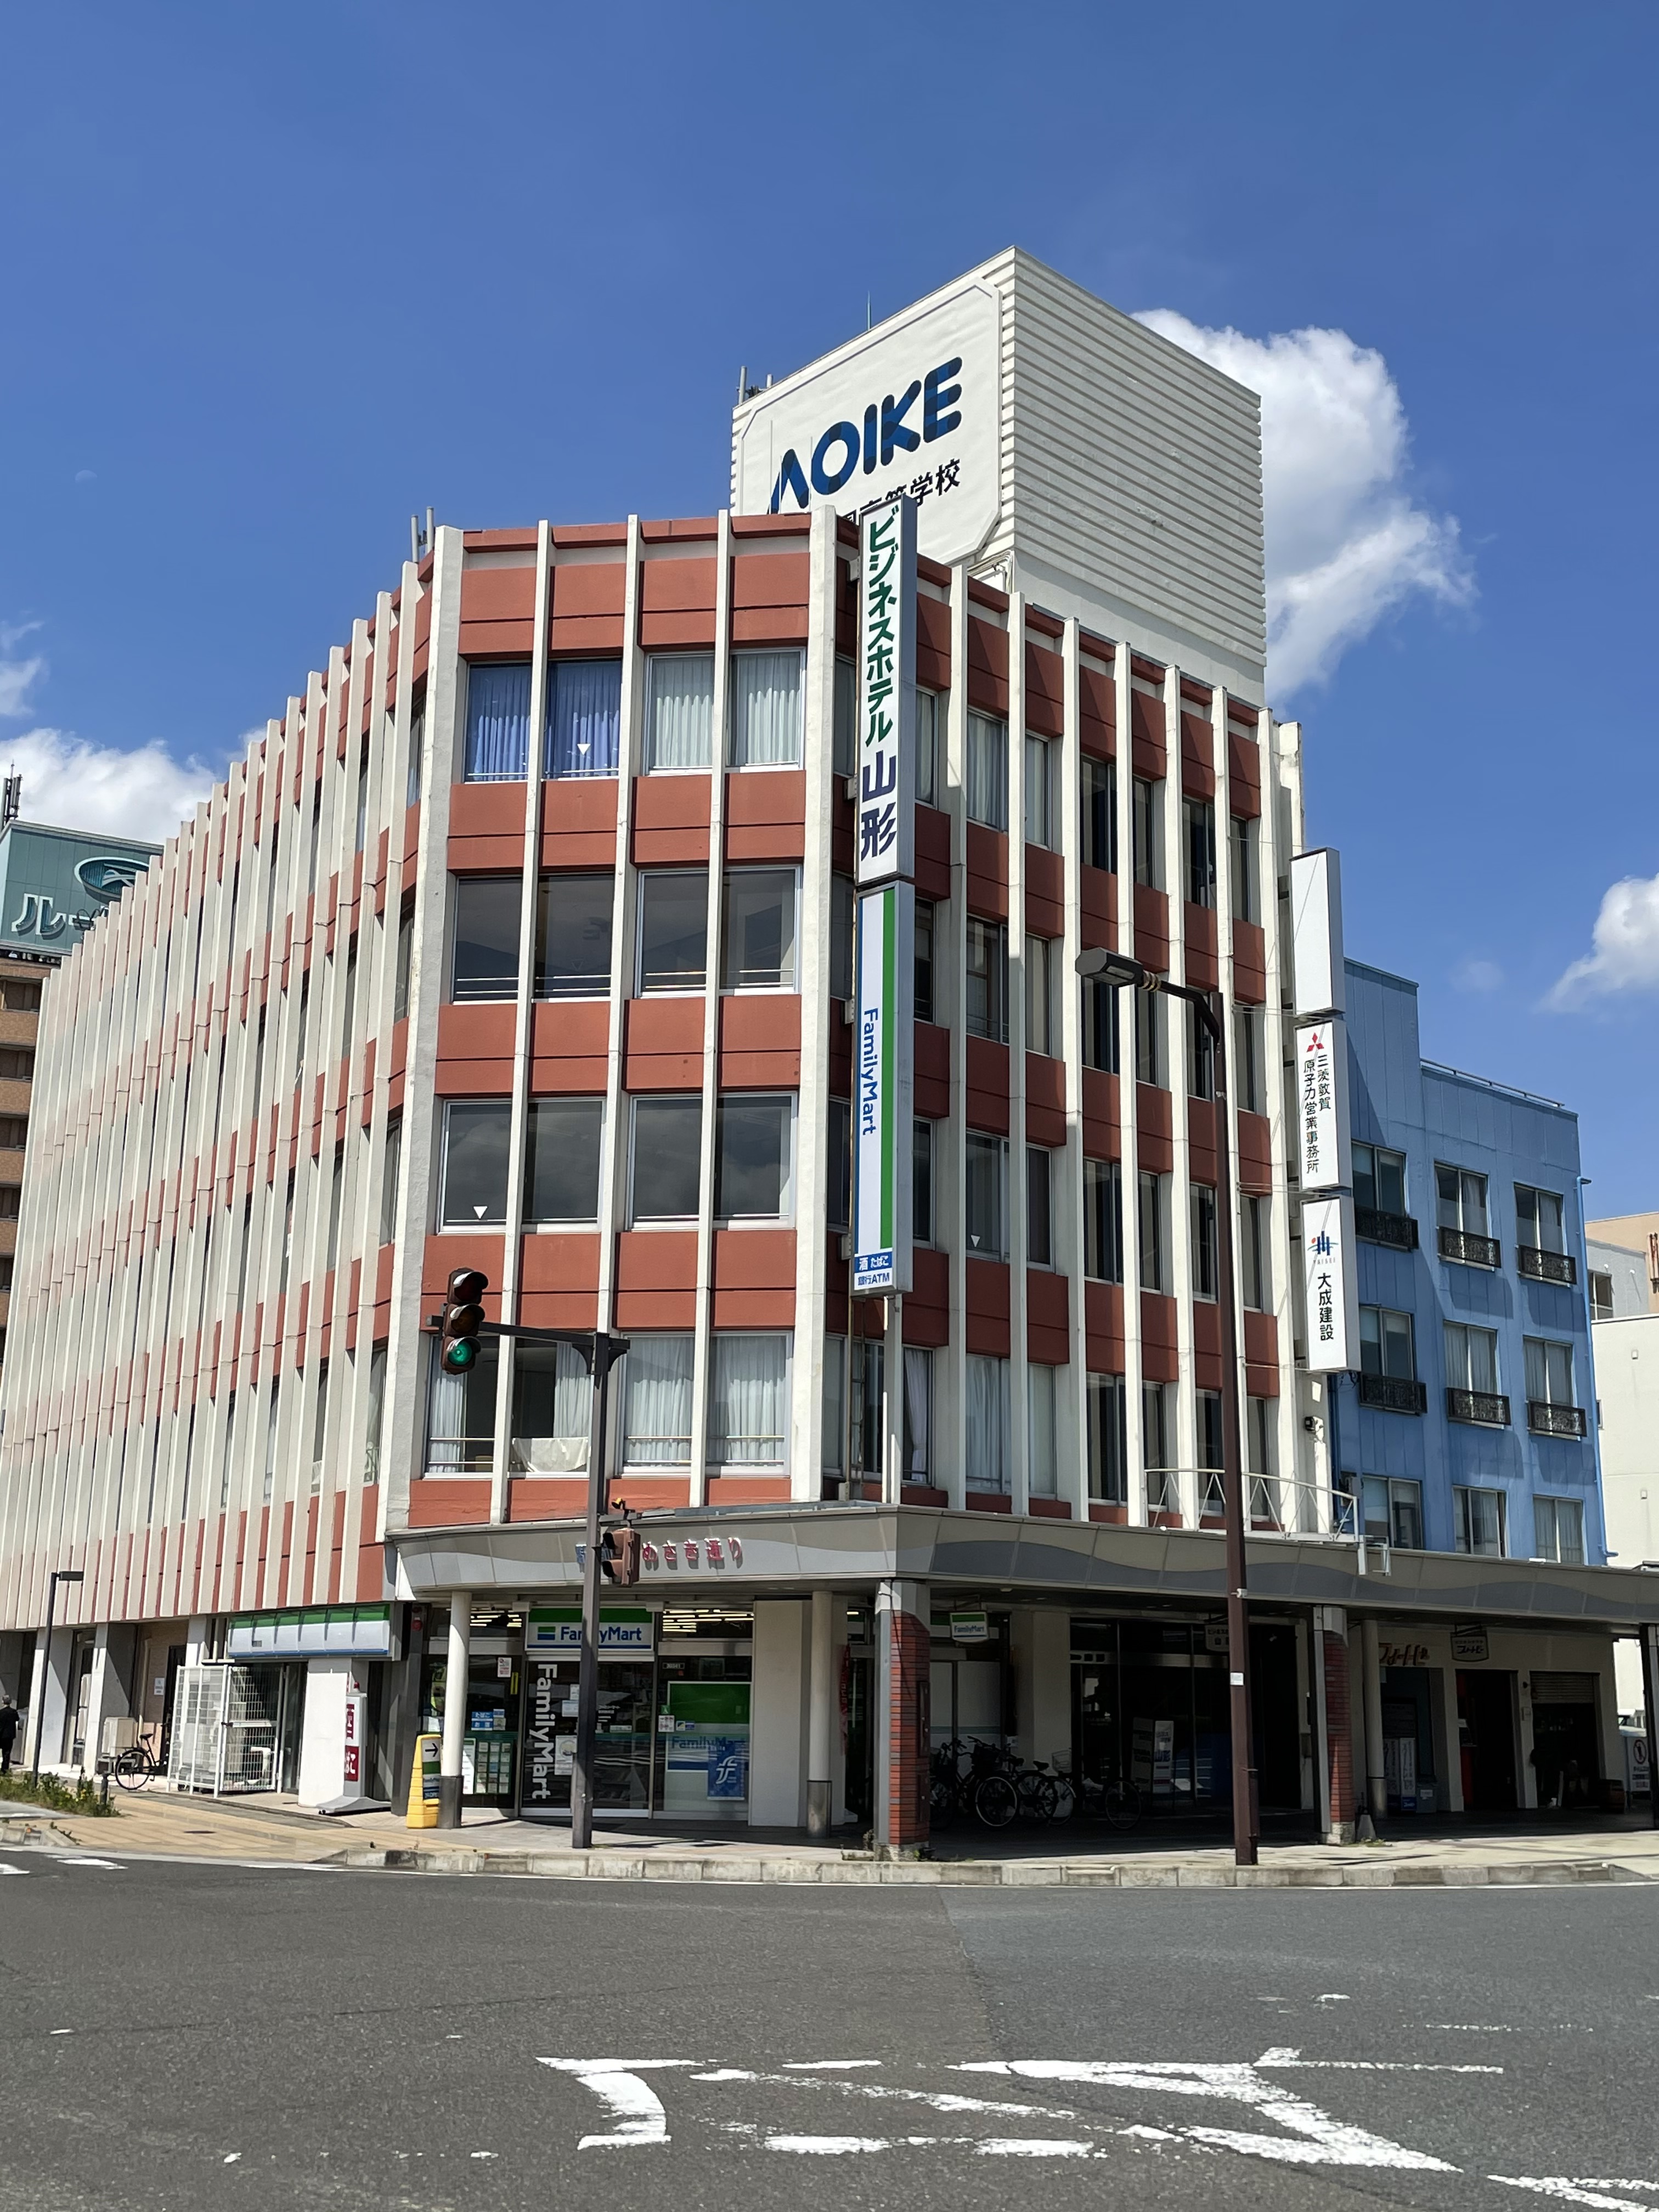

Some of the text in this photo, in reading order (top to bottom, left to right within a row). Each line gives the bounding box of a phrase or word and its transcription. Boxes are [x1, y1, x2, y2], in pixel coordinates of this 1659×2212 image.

[768, 357, 962, 514] AOIKE
[862, 1008, 878, 1136] FamilyMart
[1317, 1272, 1334, 1341] 大成建設
[561, 1627, 642, 1643] FayMart
[529, 1664, 558, 1799] FamilyMart
